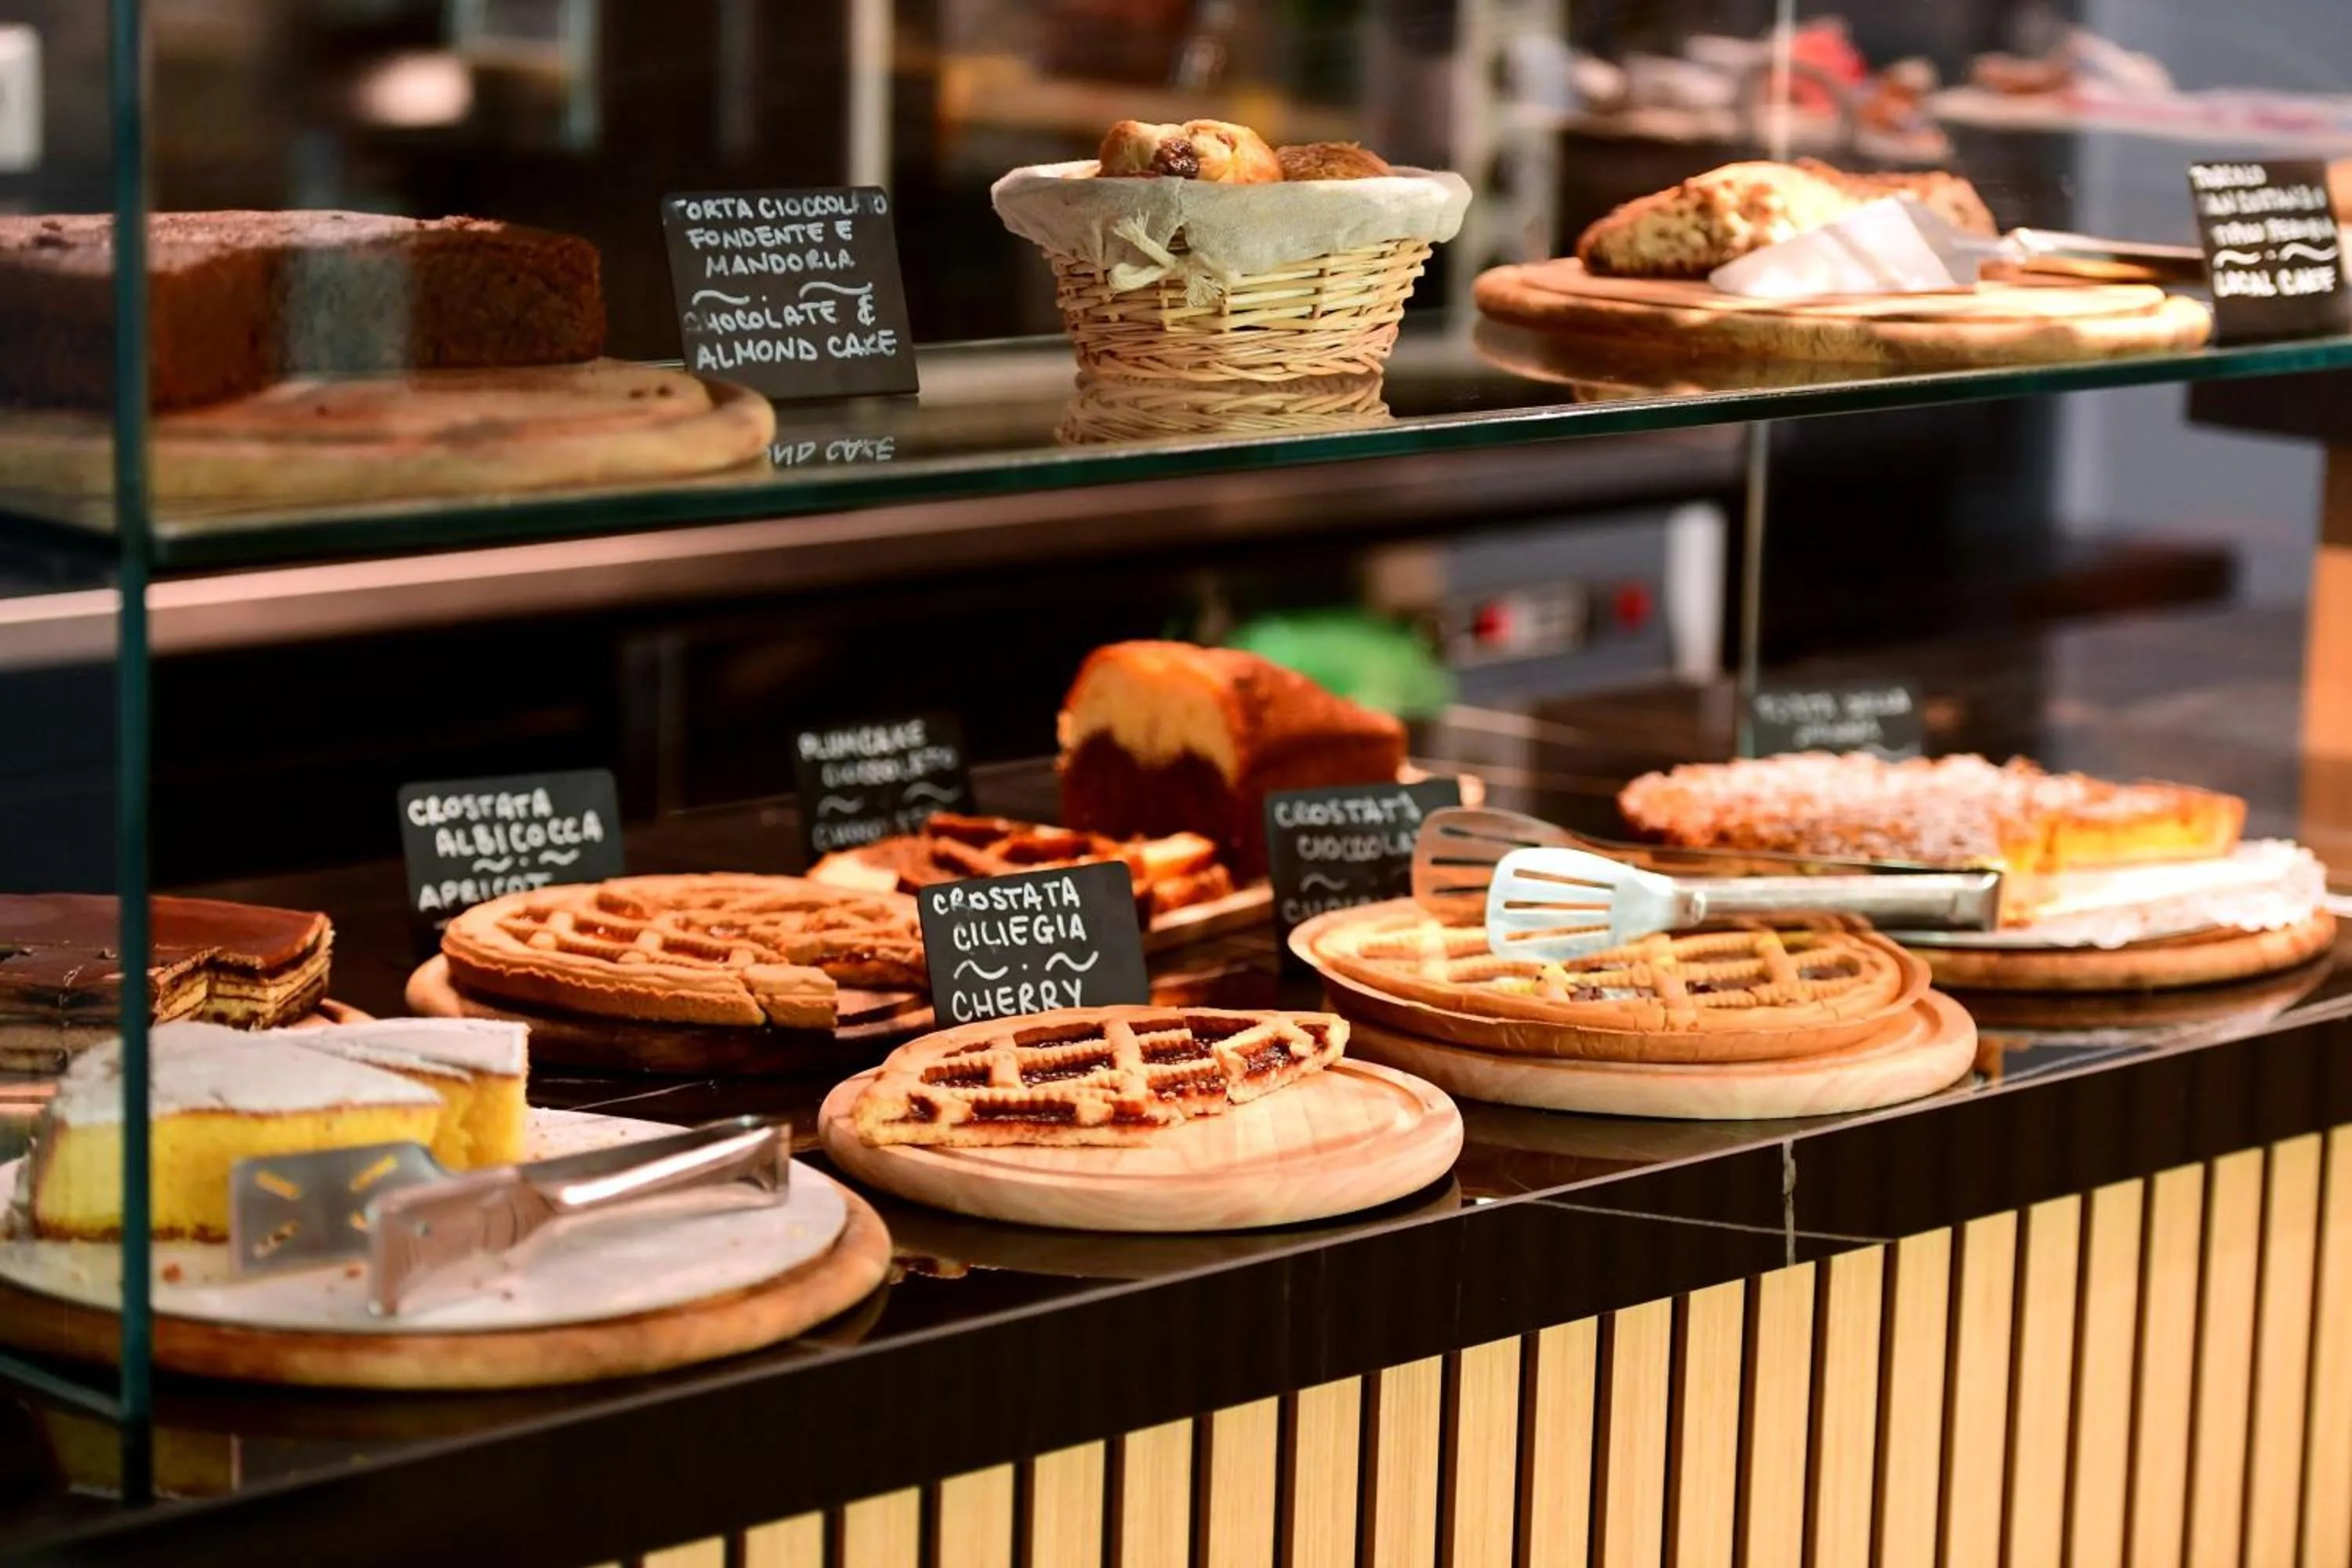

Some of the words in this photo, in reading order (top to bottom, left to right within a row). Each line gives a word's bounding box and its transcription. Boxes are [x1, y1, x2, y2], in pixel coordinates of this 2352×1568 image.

[758, 191, 887, 220] CIOCCOLAO
[685, 222, 826, 250] FONDENTE
[834, 220, 853, 241] E
[706, 249, 855, 278] MANDORLA
[696, 337, 818, 371] ALMOND
[826, 329, 898, 358] CAKE
[434, 809, 604, 858] ALBICOCCA
[417, 871, 554, 913] APRICOT
[931, 876, 1082, 916] CROSTATA
[953, 913, 1088, 952] CILIEGIA
[951, 978, 1083, 1023] CHERRY
